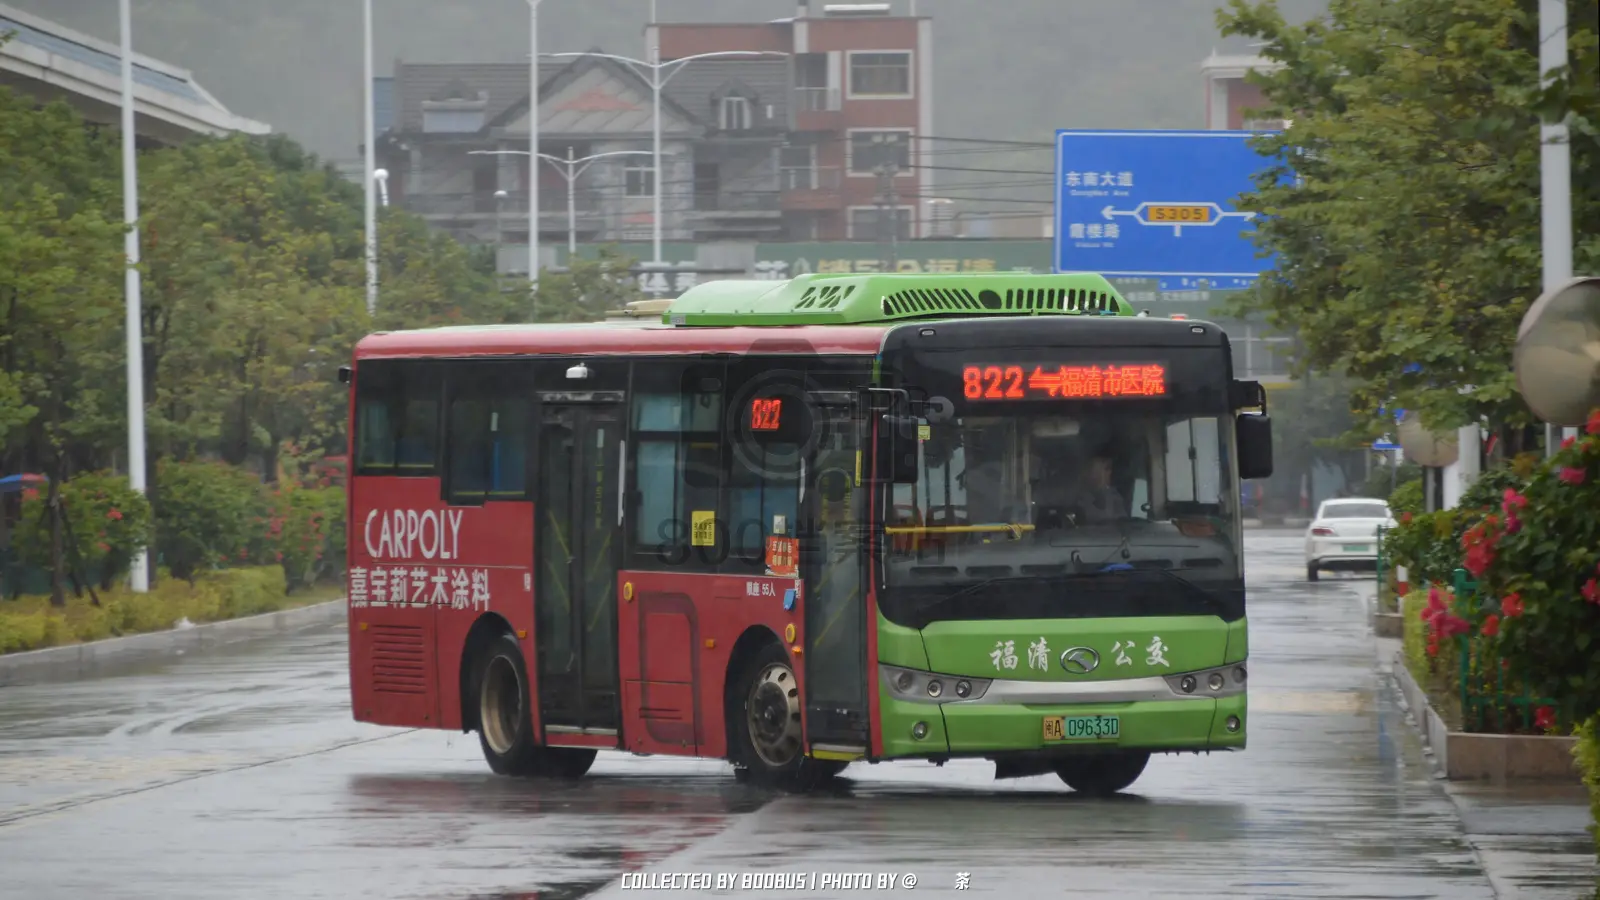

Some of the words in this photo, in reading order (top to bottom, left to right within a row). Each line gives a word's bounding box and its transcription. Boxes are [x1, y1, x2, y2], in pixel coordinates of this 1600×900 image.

[1065, 171, 1134, 187] 东南大道
[1154, 207, 1204, 220] S305
[963, 366, 1024, 398] 822
[1059, 364, 1165, 396] 福清市医院
[751, 398, 781, 430] 822
[364, 508, 464, 560] CARPOLY
[350, 565, 491, 612] 嘉宝莉艺术涂料
[989, 636, 1051, 673] 福清
[1111, 635, 1171, 668] 公交
[1068, 718, 1119, 736] 09633D
